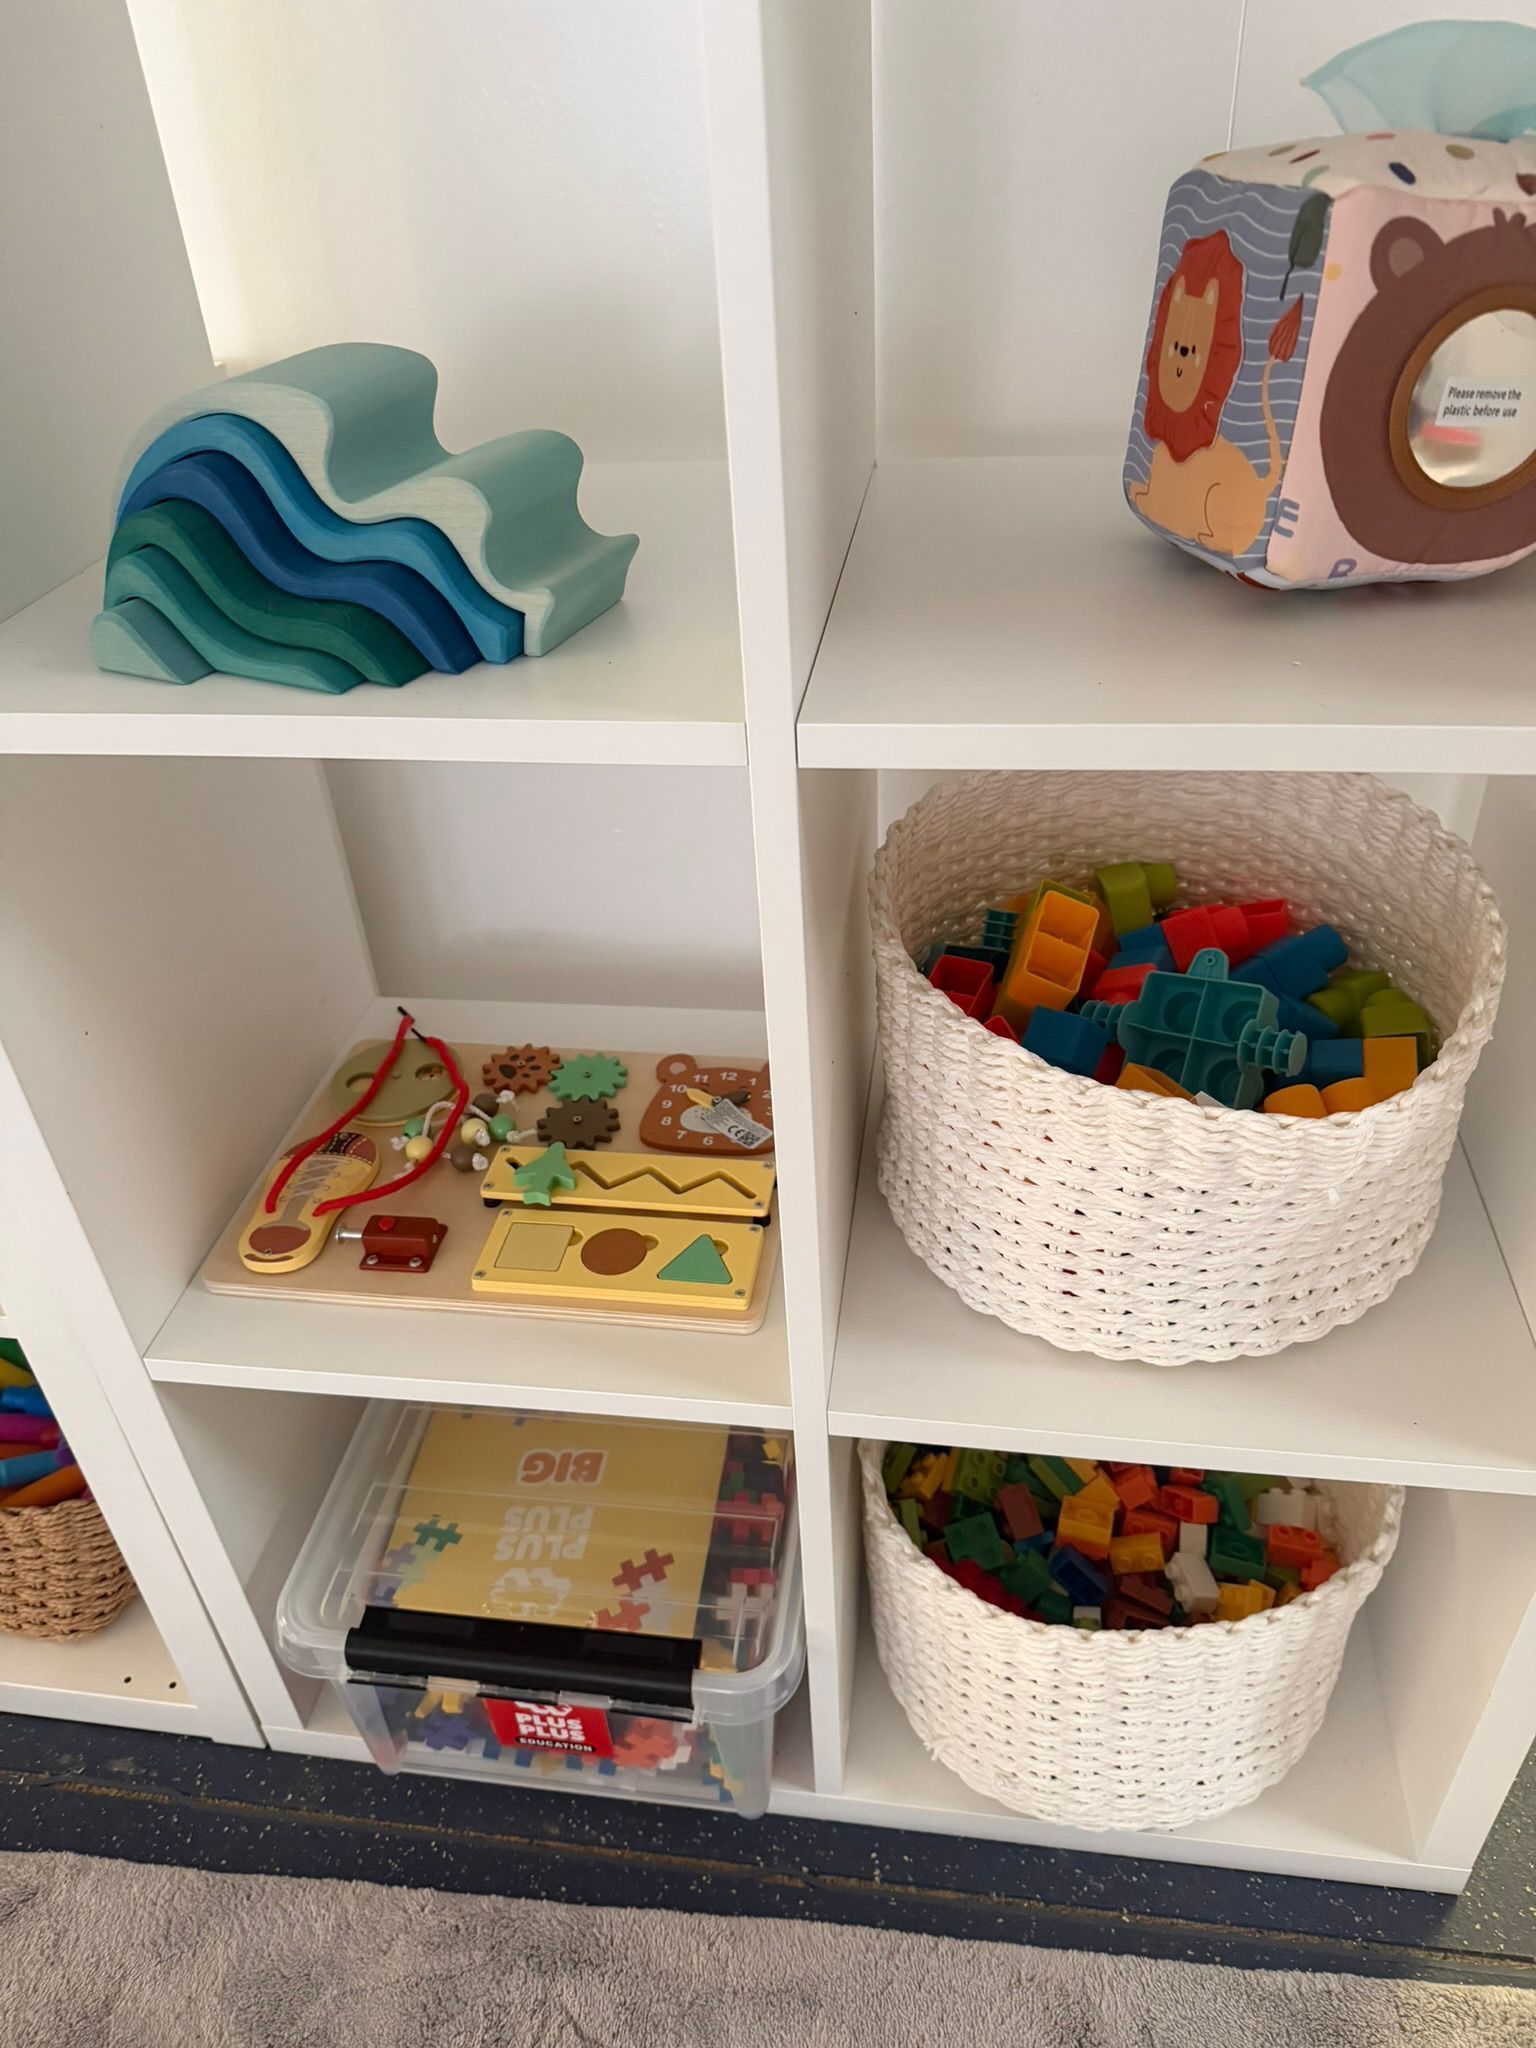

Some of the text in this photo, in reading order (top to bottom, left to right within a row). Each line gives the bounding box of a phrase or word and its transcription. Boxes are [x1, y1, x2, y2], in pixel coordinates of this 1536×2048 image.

[1448, 386, 1522, 400] Please remove the
[1442, 404, 1517, 418] plastic before use
[693, 1074, 709, 1083] 11
[719, 1071, 738, 1081] 12
[748, 1077, 757, 1086] 1
[669, 1084, 688, 1093] 10
[661, 1099, 672, 1109] 9
[660, 1116, 672, 1126] 8
[676, 1130, 687, 1140] 7
[702, 1136, 714, 1146] 6
[518, 1450, 605, 1485] BIG
[502, 1505, 594, 1533] PLUS
[494, 1534, 590, 1561] PLUS
[515, 1713, 583, 1730] PLUS
[519, 1724, 586, 1742] PLUS
[519, 1737, 593, 1752] EDUCATION
